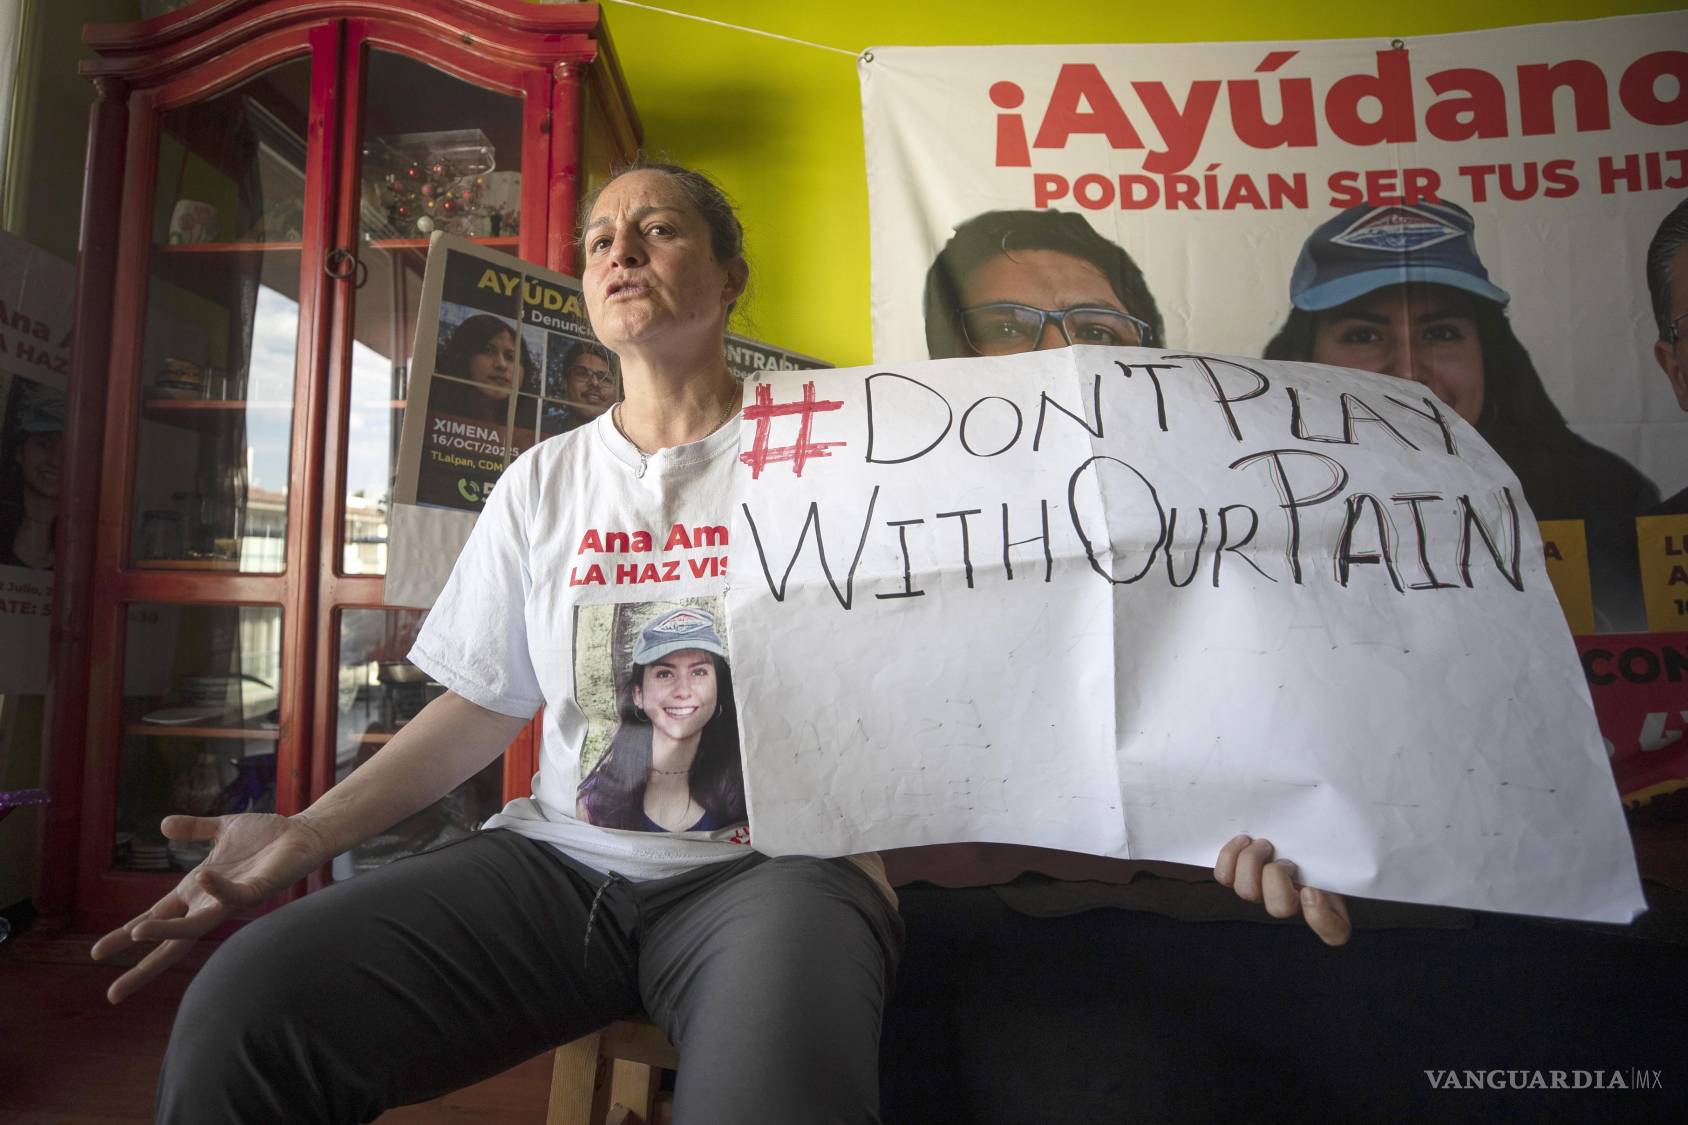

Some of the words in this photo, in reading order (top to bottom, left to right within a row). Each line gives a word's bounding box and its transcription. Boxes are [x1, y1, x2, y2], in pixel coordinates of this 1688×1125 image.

[1034, 163, 1308, 210] PODRÍAN
[1328, 169, 1441, 208] SER
[1459, 159, 1579, 203] TUS
[477, 267, 588, 320] AYÚDA
[531, 310, 594, 337] Denunci
[433, 418, 500, 443] XIMENA
[478, 459, 504, 472] CDM
[577, 528, 652, 555] Ana
[569, 563, 606, 587] LA
[615, 560, 681, 585] HAZ
